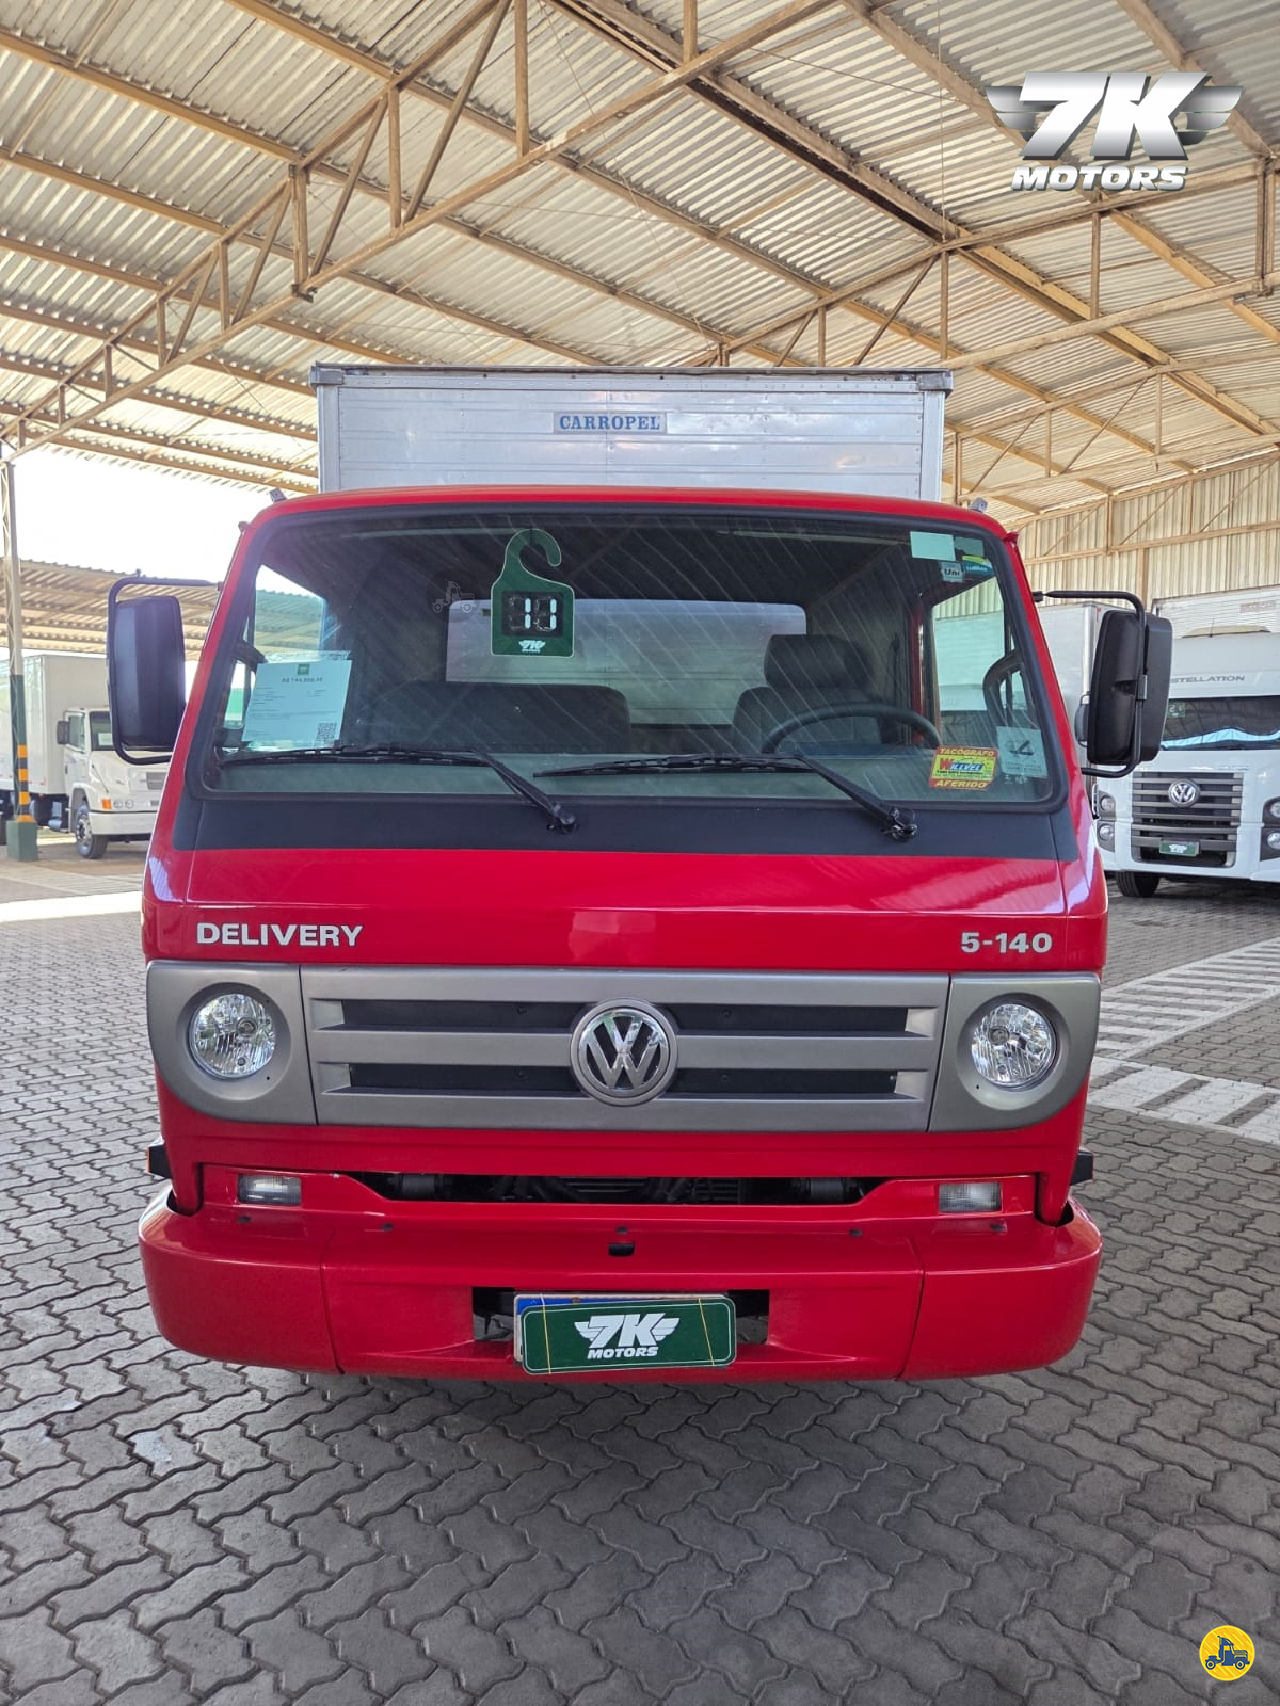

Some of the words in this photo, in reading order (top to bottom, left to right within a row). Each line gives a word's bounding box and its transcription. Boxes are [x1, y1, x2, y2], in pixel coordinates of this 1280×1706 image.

[559, 415, 660, 431] CARROPEL
[1170, 675, 1246, 683] STELLATION
[196, 922, 363, 947] DELIVERY
[961, 932, 1053, 954] 5-140
[588, 1313, 667, 1349] 7K
[587, 1347, 659, 1360] MOTORS
